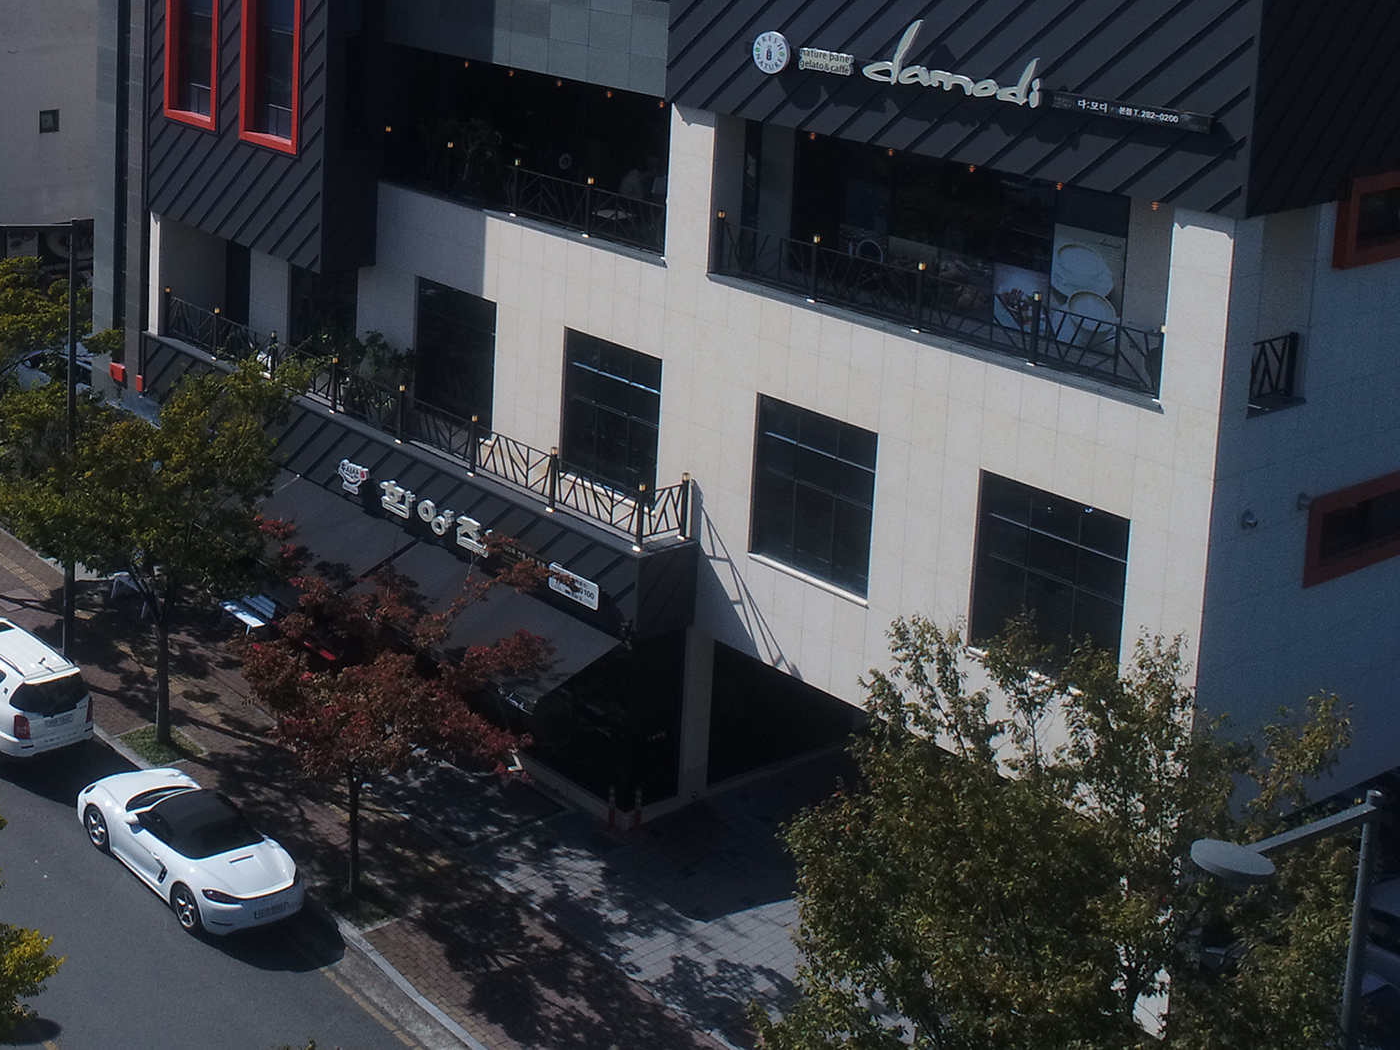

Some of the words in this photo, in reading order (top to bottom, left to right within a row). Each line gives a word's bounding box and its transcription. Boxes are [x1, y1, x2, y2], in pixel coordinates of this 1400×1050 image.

[757, 35, 785, 51] FRESH
[755, 53, 783, 71] NATURE
[800, 49, 827, 60] nature
[862, 19, 1040, 109] damodi
